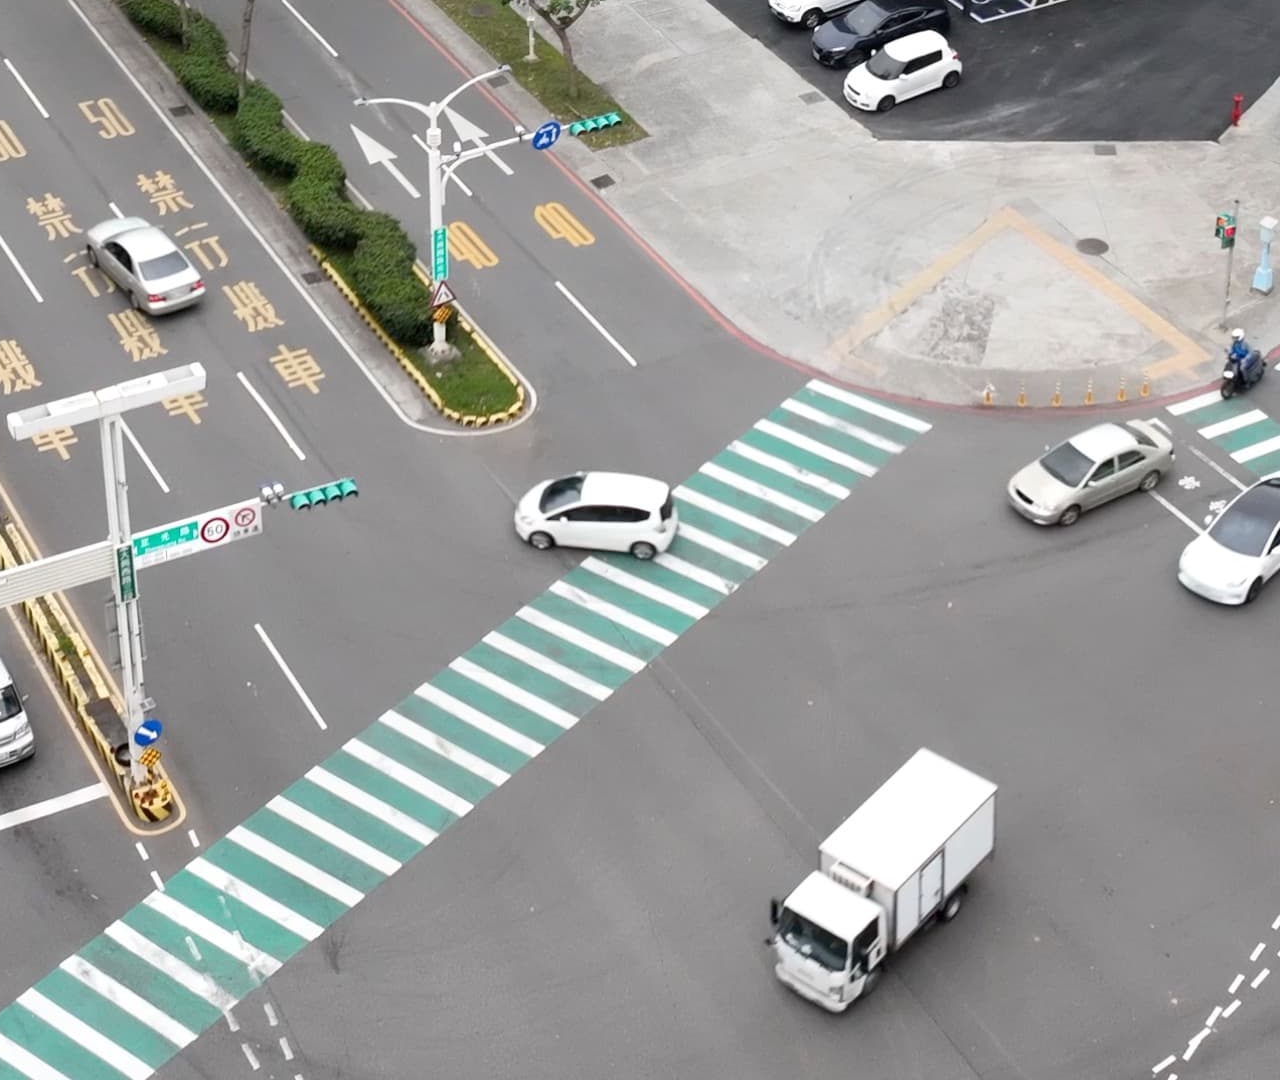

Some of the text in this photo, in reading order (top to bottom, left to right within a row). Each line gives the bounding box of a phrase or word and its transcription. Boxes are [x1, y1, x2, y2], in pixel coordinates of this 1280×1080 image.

[78, 97, 136, 140] 50
[136, 169, 326, 395] 禁行機車
